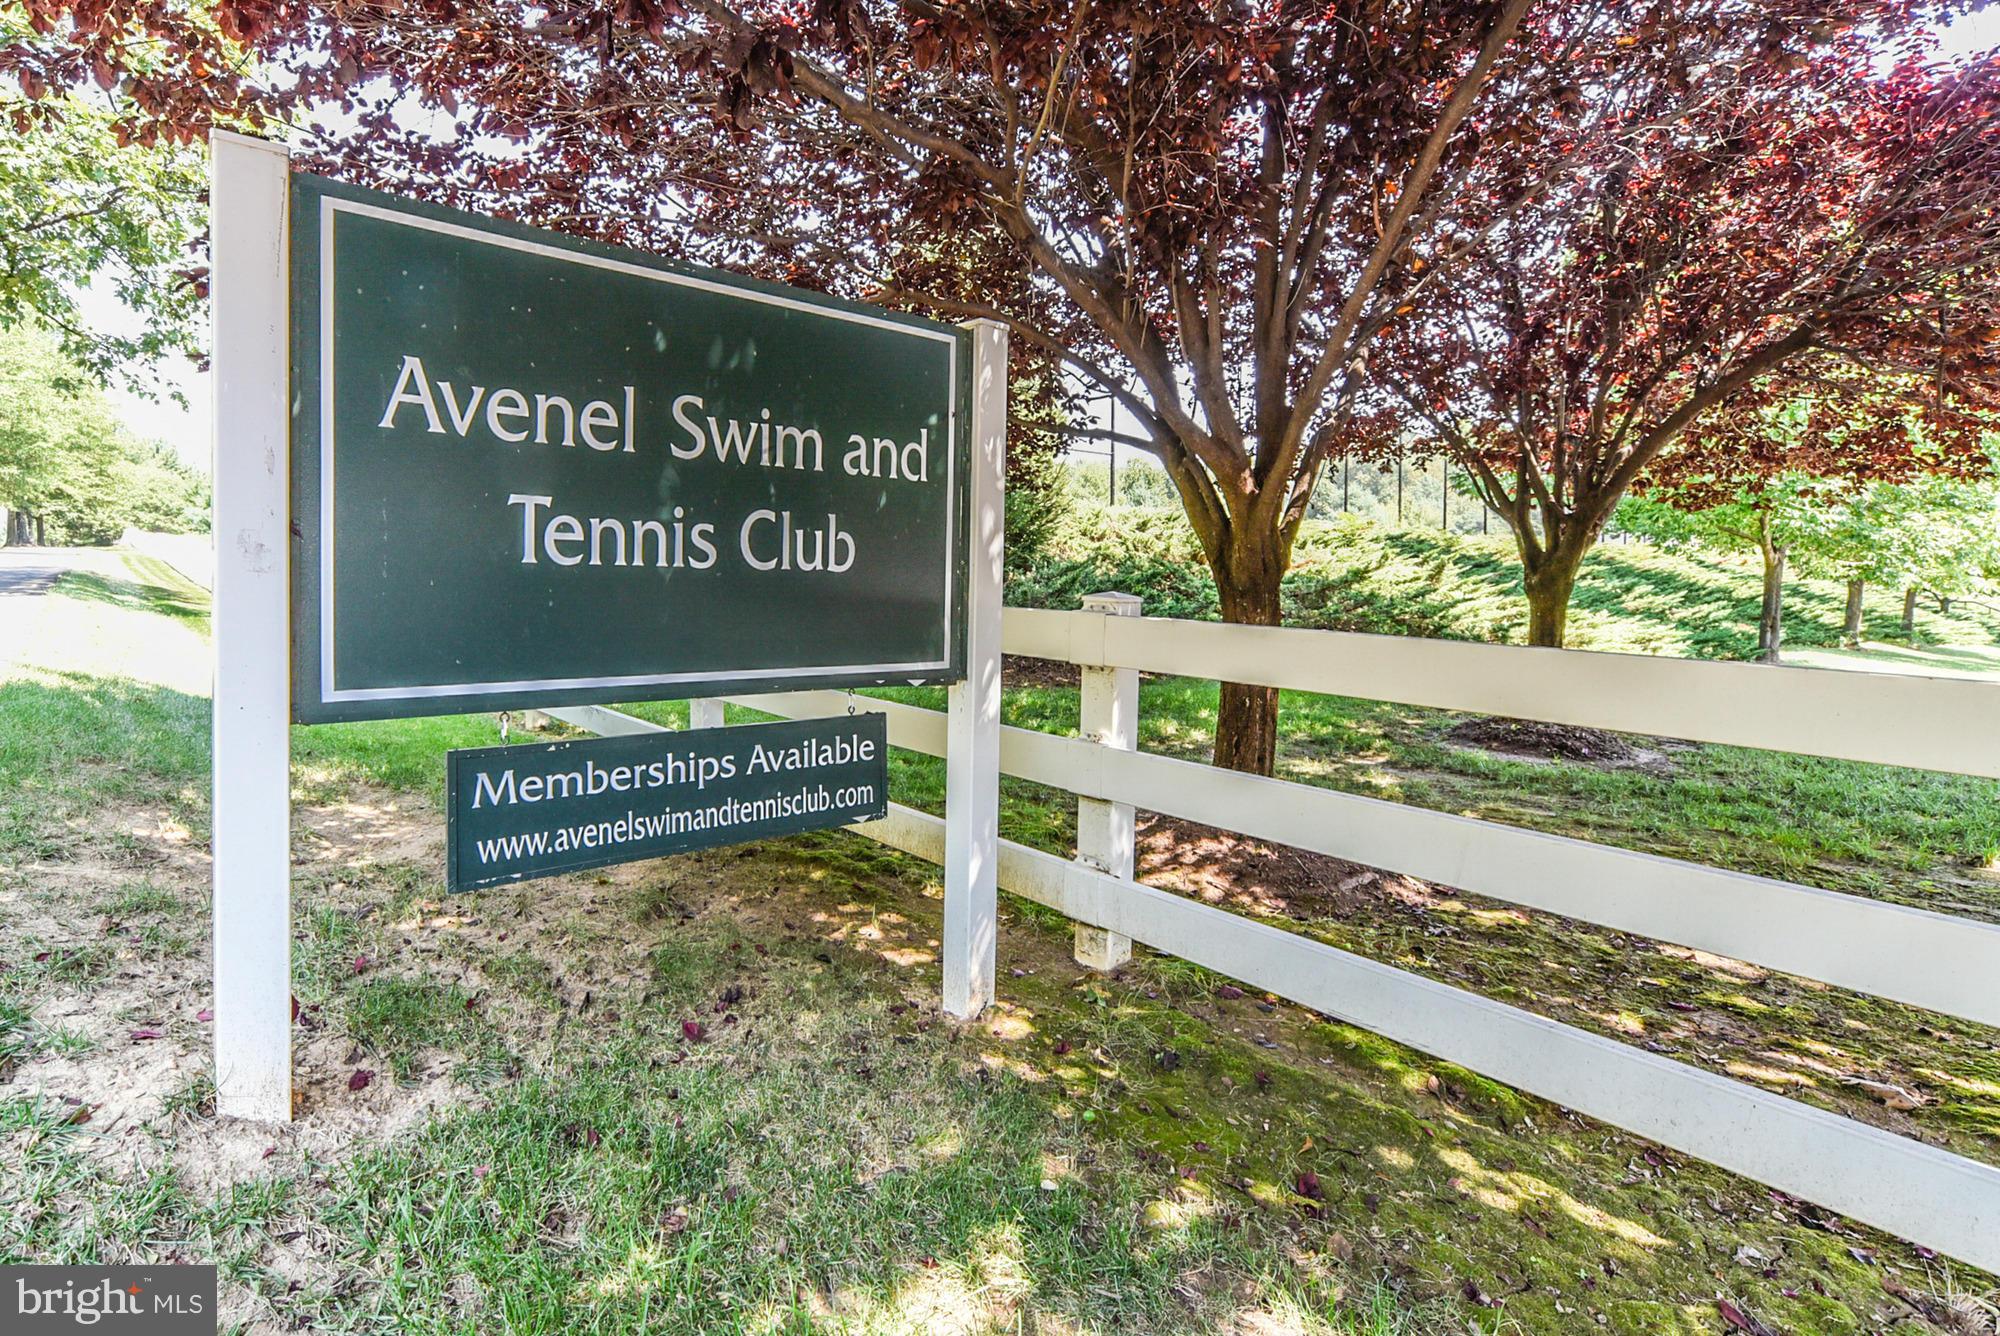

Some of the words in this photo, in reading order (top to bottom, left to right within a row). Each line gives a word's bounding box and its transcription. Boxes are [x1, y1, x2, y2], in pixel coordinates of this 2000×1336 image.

[378, 355, 637, 454] Avenel
[669, 394, 825, 472] Swim
[843, 428, 929, 482] and
[507, 493, 718, 569] Tennis
[740, 509, 857, 574] Club
[471, 752, 737, 810] Memberships
[745, 733, 876, 777] Available
[476, 783, 875, 865] www.avenelswimandtennisclub.com
